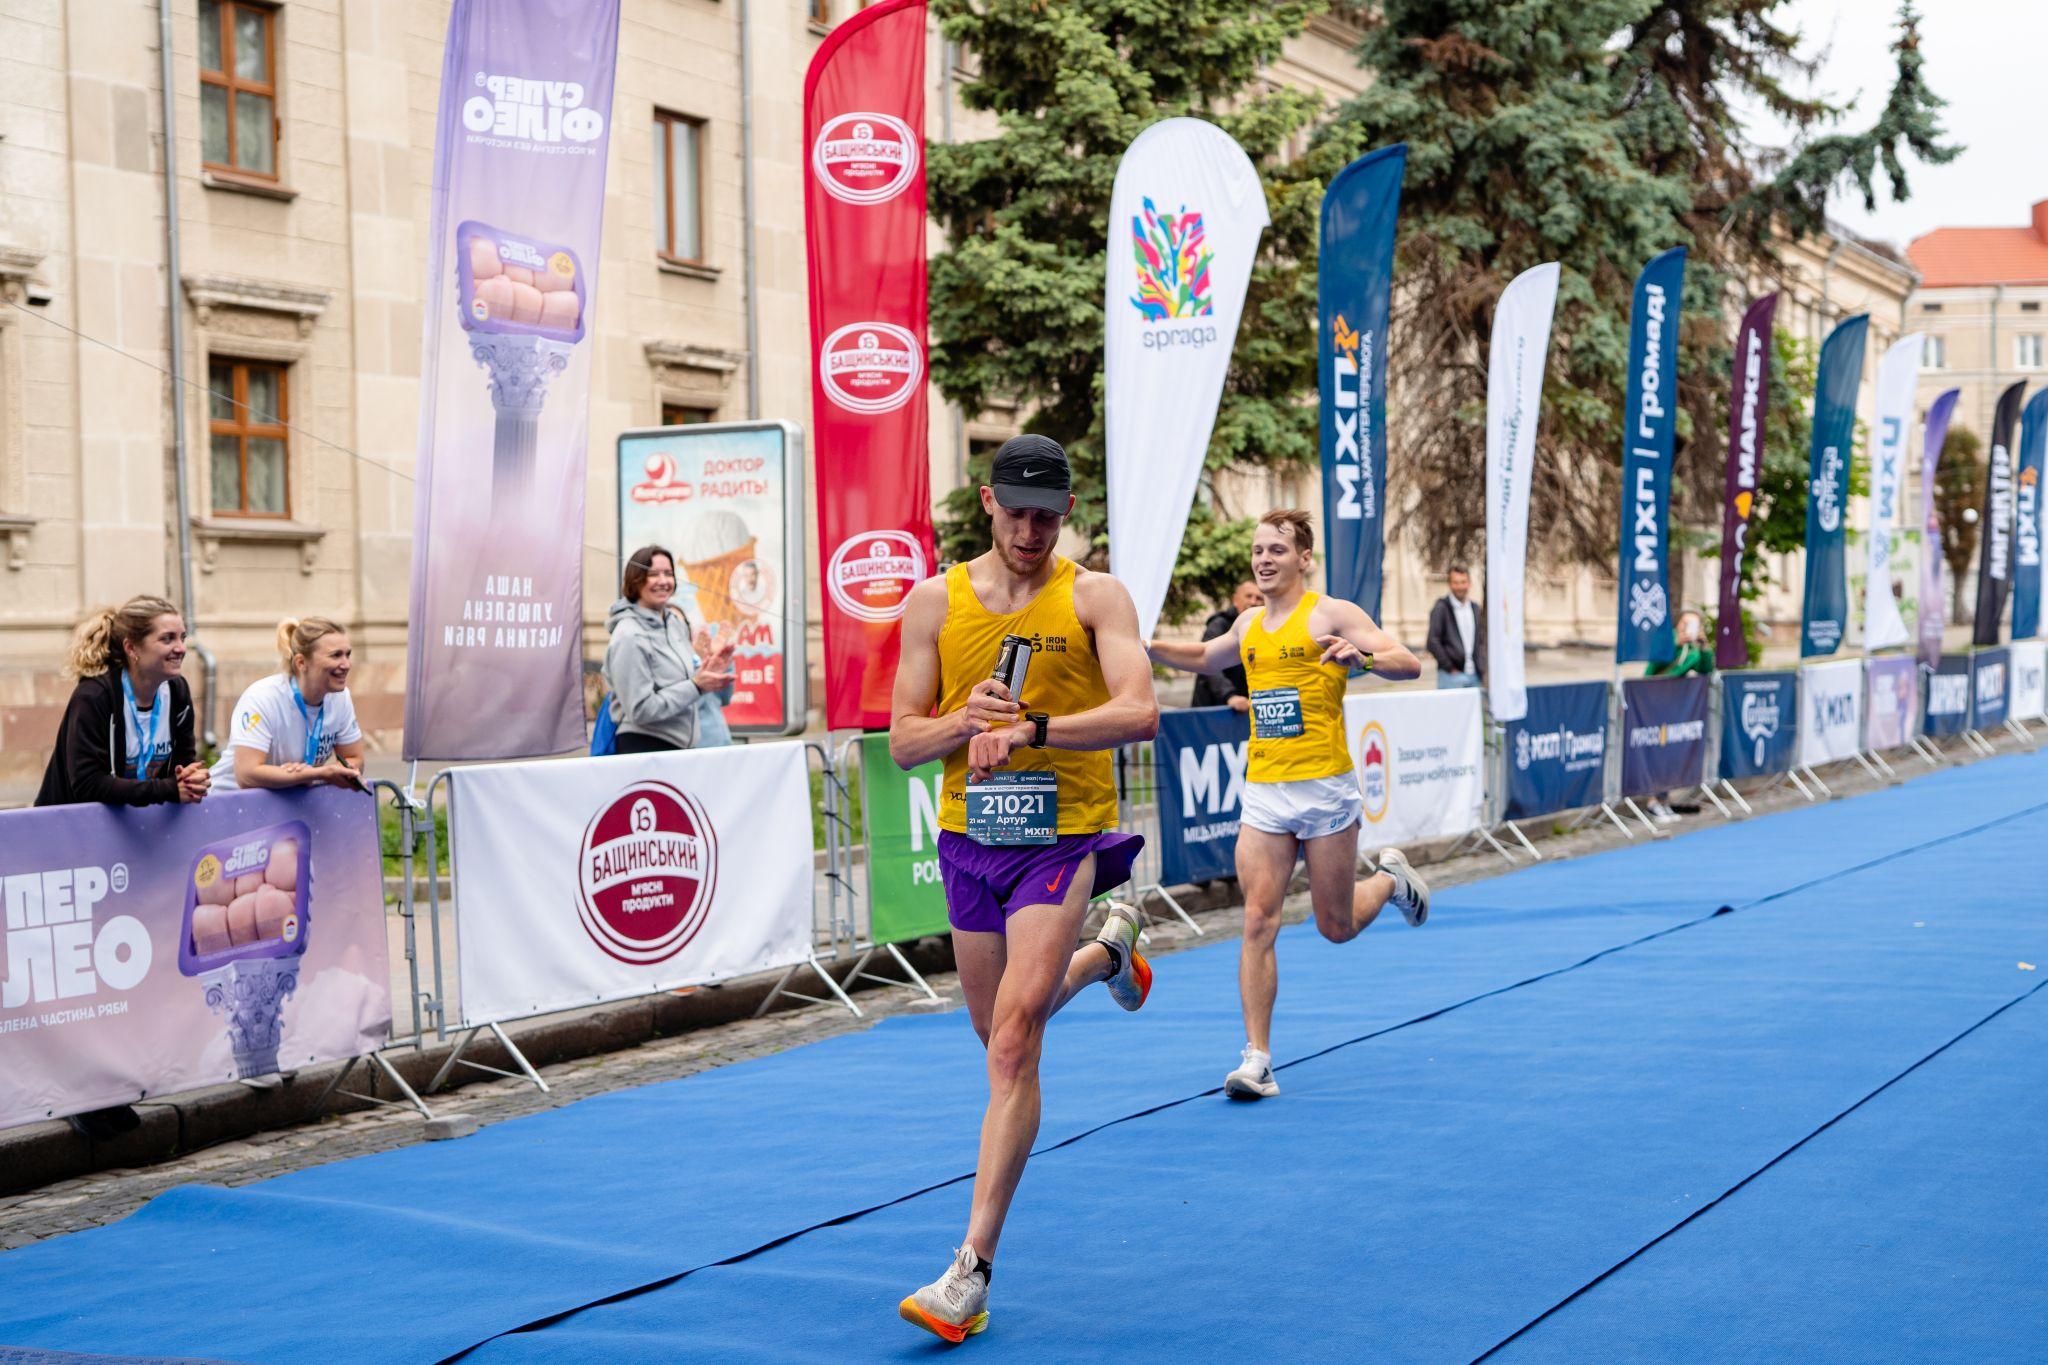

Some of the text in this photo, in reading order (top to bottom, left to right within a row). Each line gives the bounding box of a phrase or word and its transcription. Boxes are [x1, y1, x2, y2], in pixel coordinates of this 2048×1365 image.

[825, 142, 902, 159] БАЩИНСЬКИЙ
[1143, 325, 1217, 350] spraga
[831, 351, 909, 370] БАЩИНСЬКИЙ
[1738, 328, 1761, 488] МАРКЕТ
[1334, 356, 1362, 520] МХП
[703, 457, 765, 477] ДОКТОР
[701, 479, 769, 498] РАДИТЬ!
[1635, 467, 1658, 572] МХП
[841, 560, 914, 580] БАЩИНСЬКИ
[1046, 644, 1067, 652] CLUB
[1256, 702, 1296, 719] 21022
[1181, 741, 1249, 819] МХ
[981, 795, 1044, 815] 21021
[996, 816, 1028, 826] Артур
[1025, 828, 1049, 836] МХП
[593, 837, 699, 884] БАЩИНСЬКИЙ
[0, 866, 109, 930] ПЕР
[2, 915, 153, 1009] ЛЕО
[40, 1005, 96, 1026] ЧАСТИНА
[97, 1000, 129, 1017] РЯБИ
